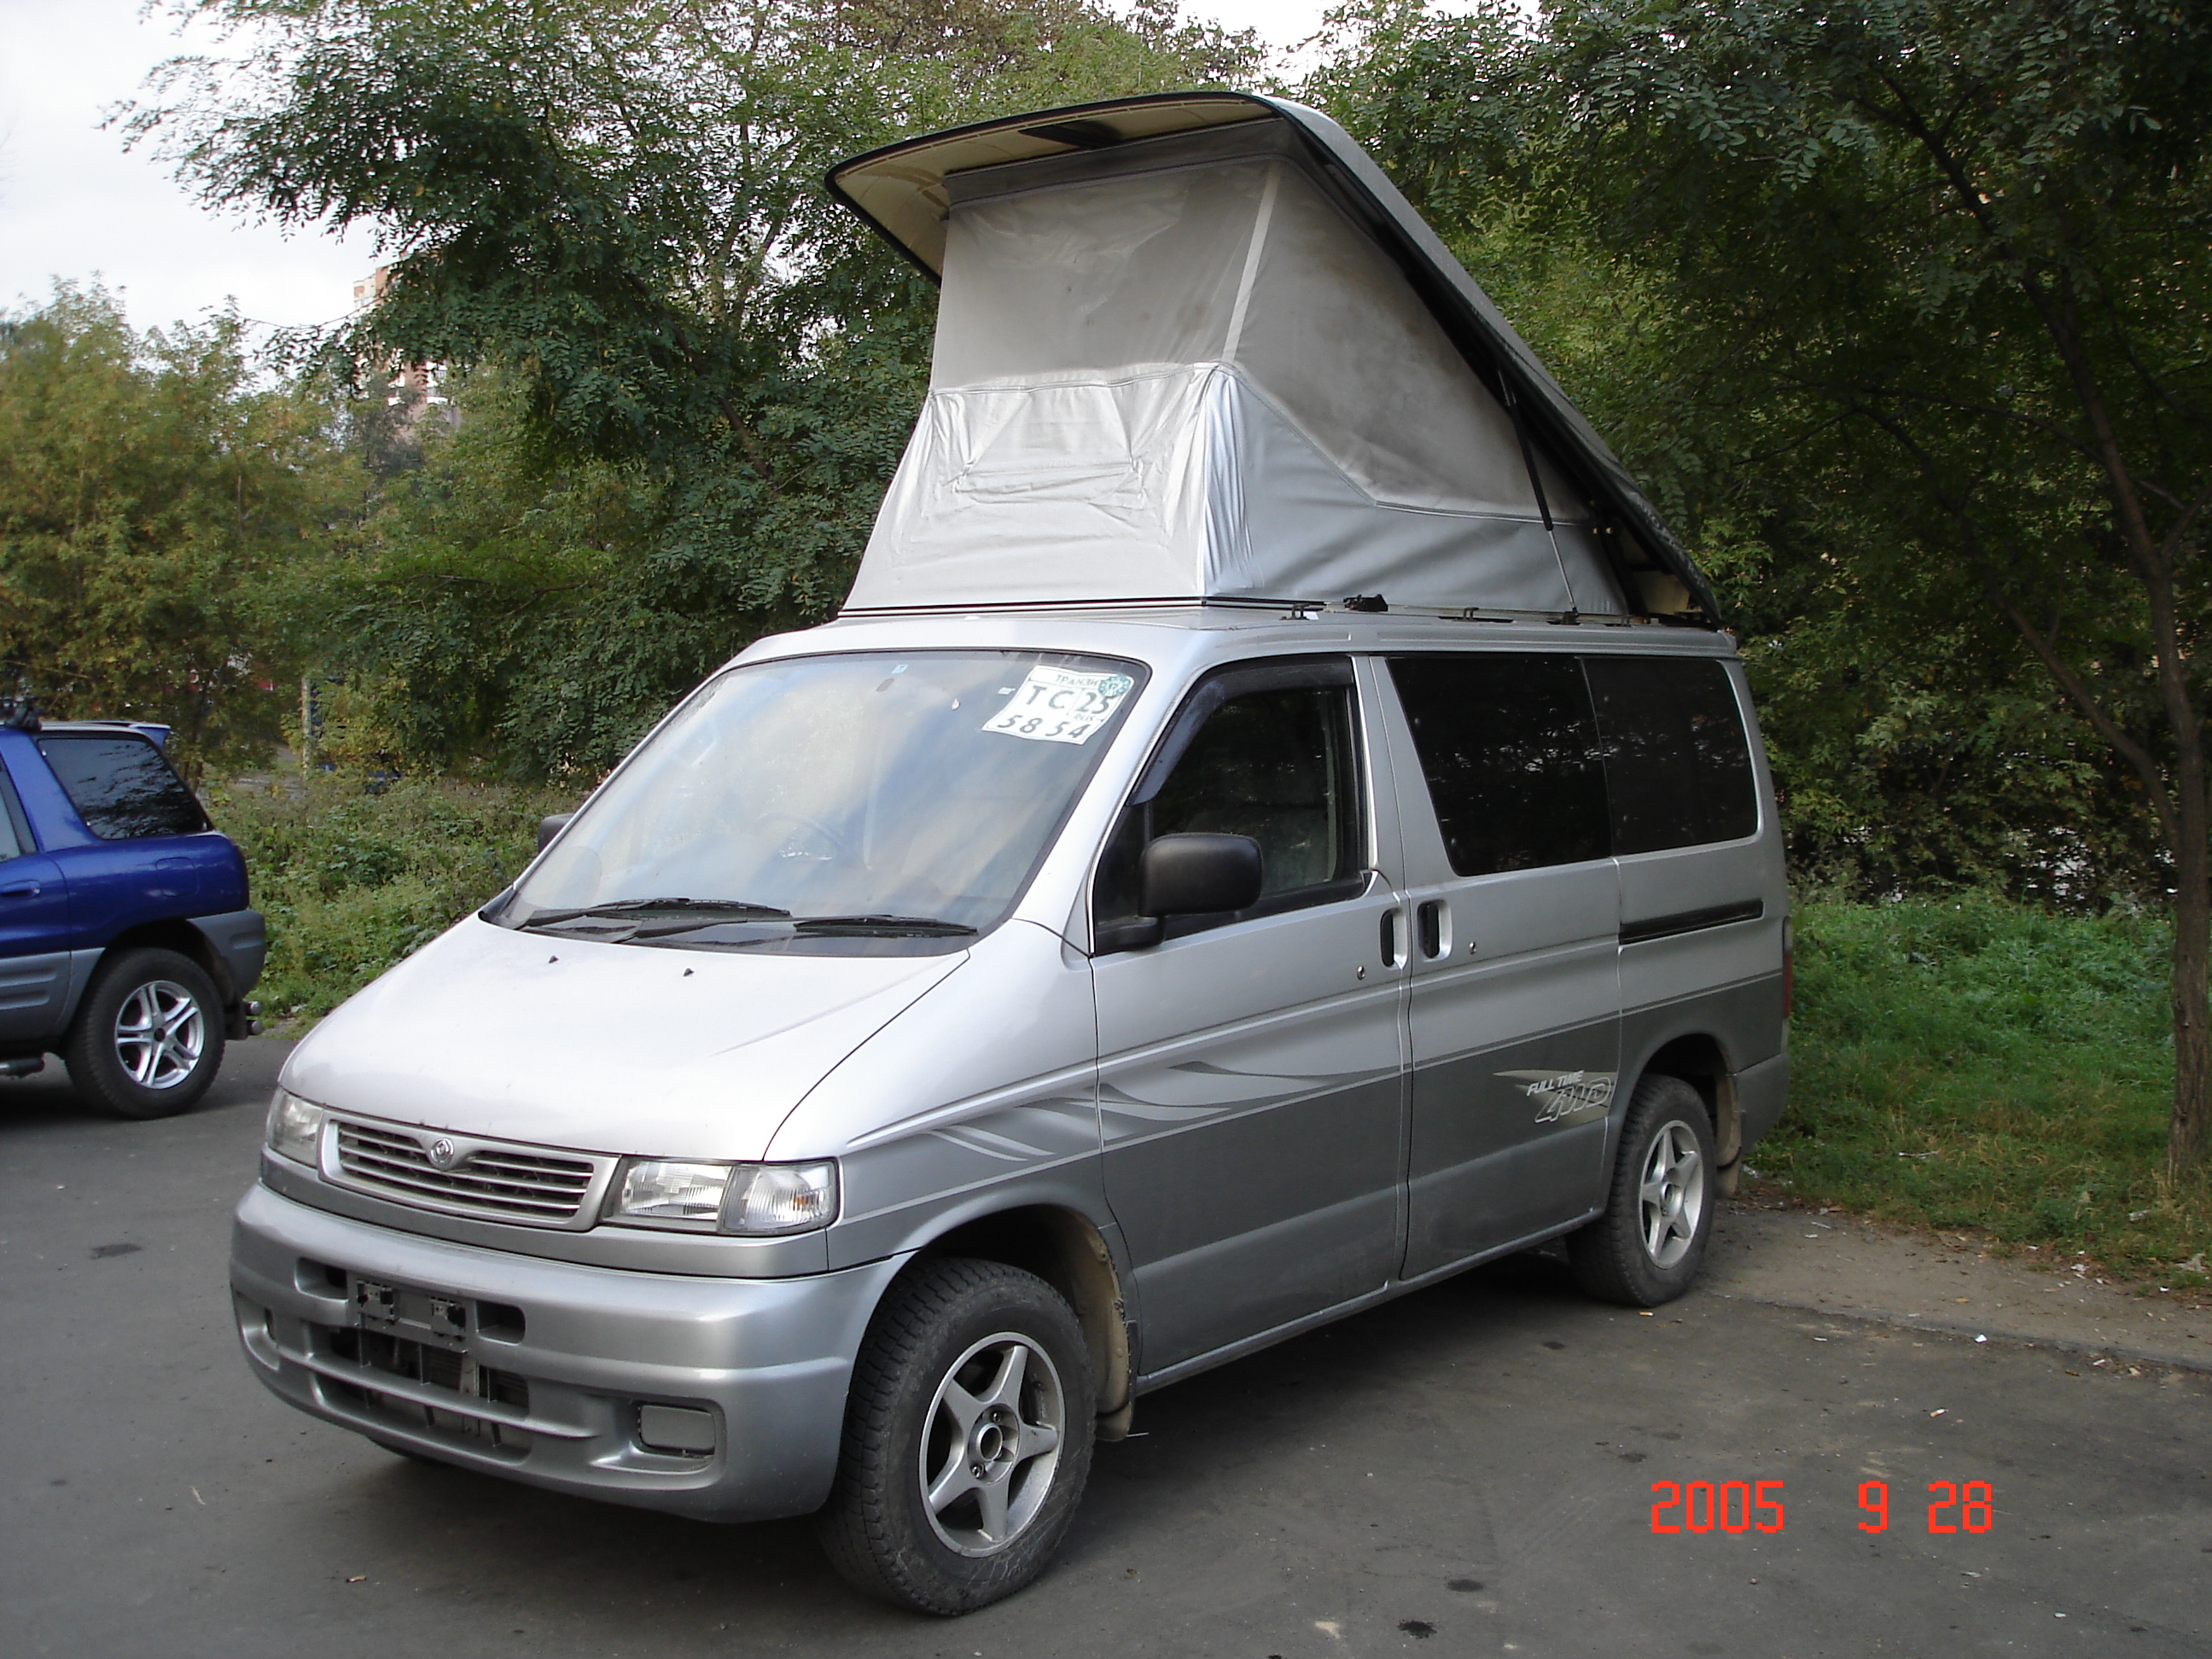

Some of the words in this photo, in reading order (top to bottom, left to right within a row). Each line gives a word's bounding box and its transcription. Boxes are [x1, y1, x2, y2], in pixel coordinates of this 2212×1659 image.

[1056, 674, 1100, 687] ТРАНЗИ
[1076, 692, 1110, 714] 25
[997, 714, 1091, 739] 5854
[1074, 714, 1095, 723] RUS
[1526, 1079, 1555, 1097] FULL
[1557, 1070, 1585, 1088] TIME
[1534, 1076, 1612, 1124] 4WD
